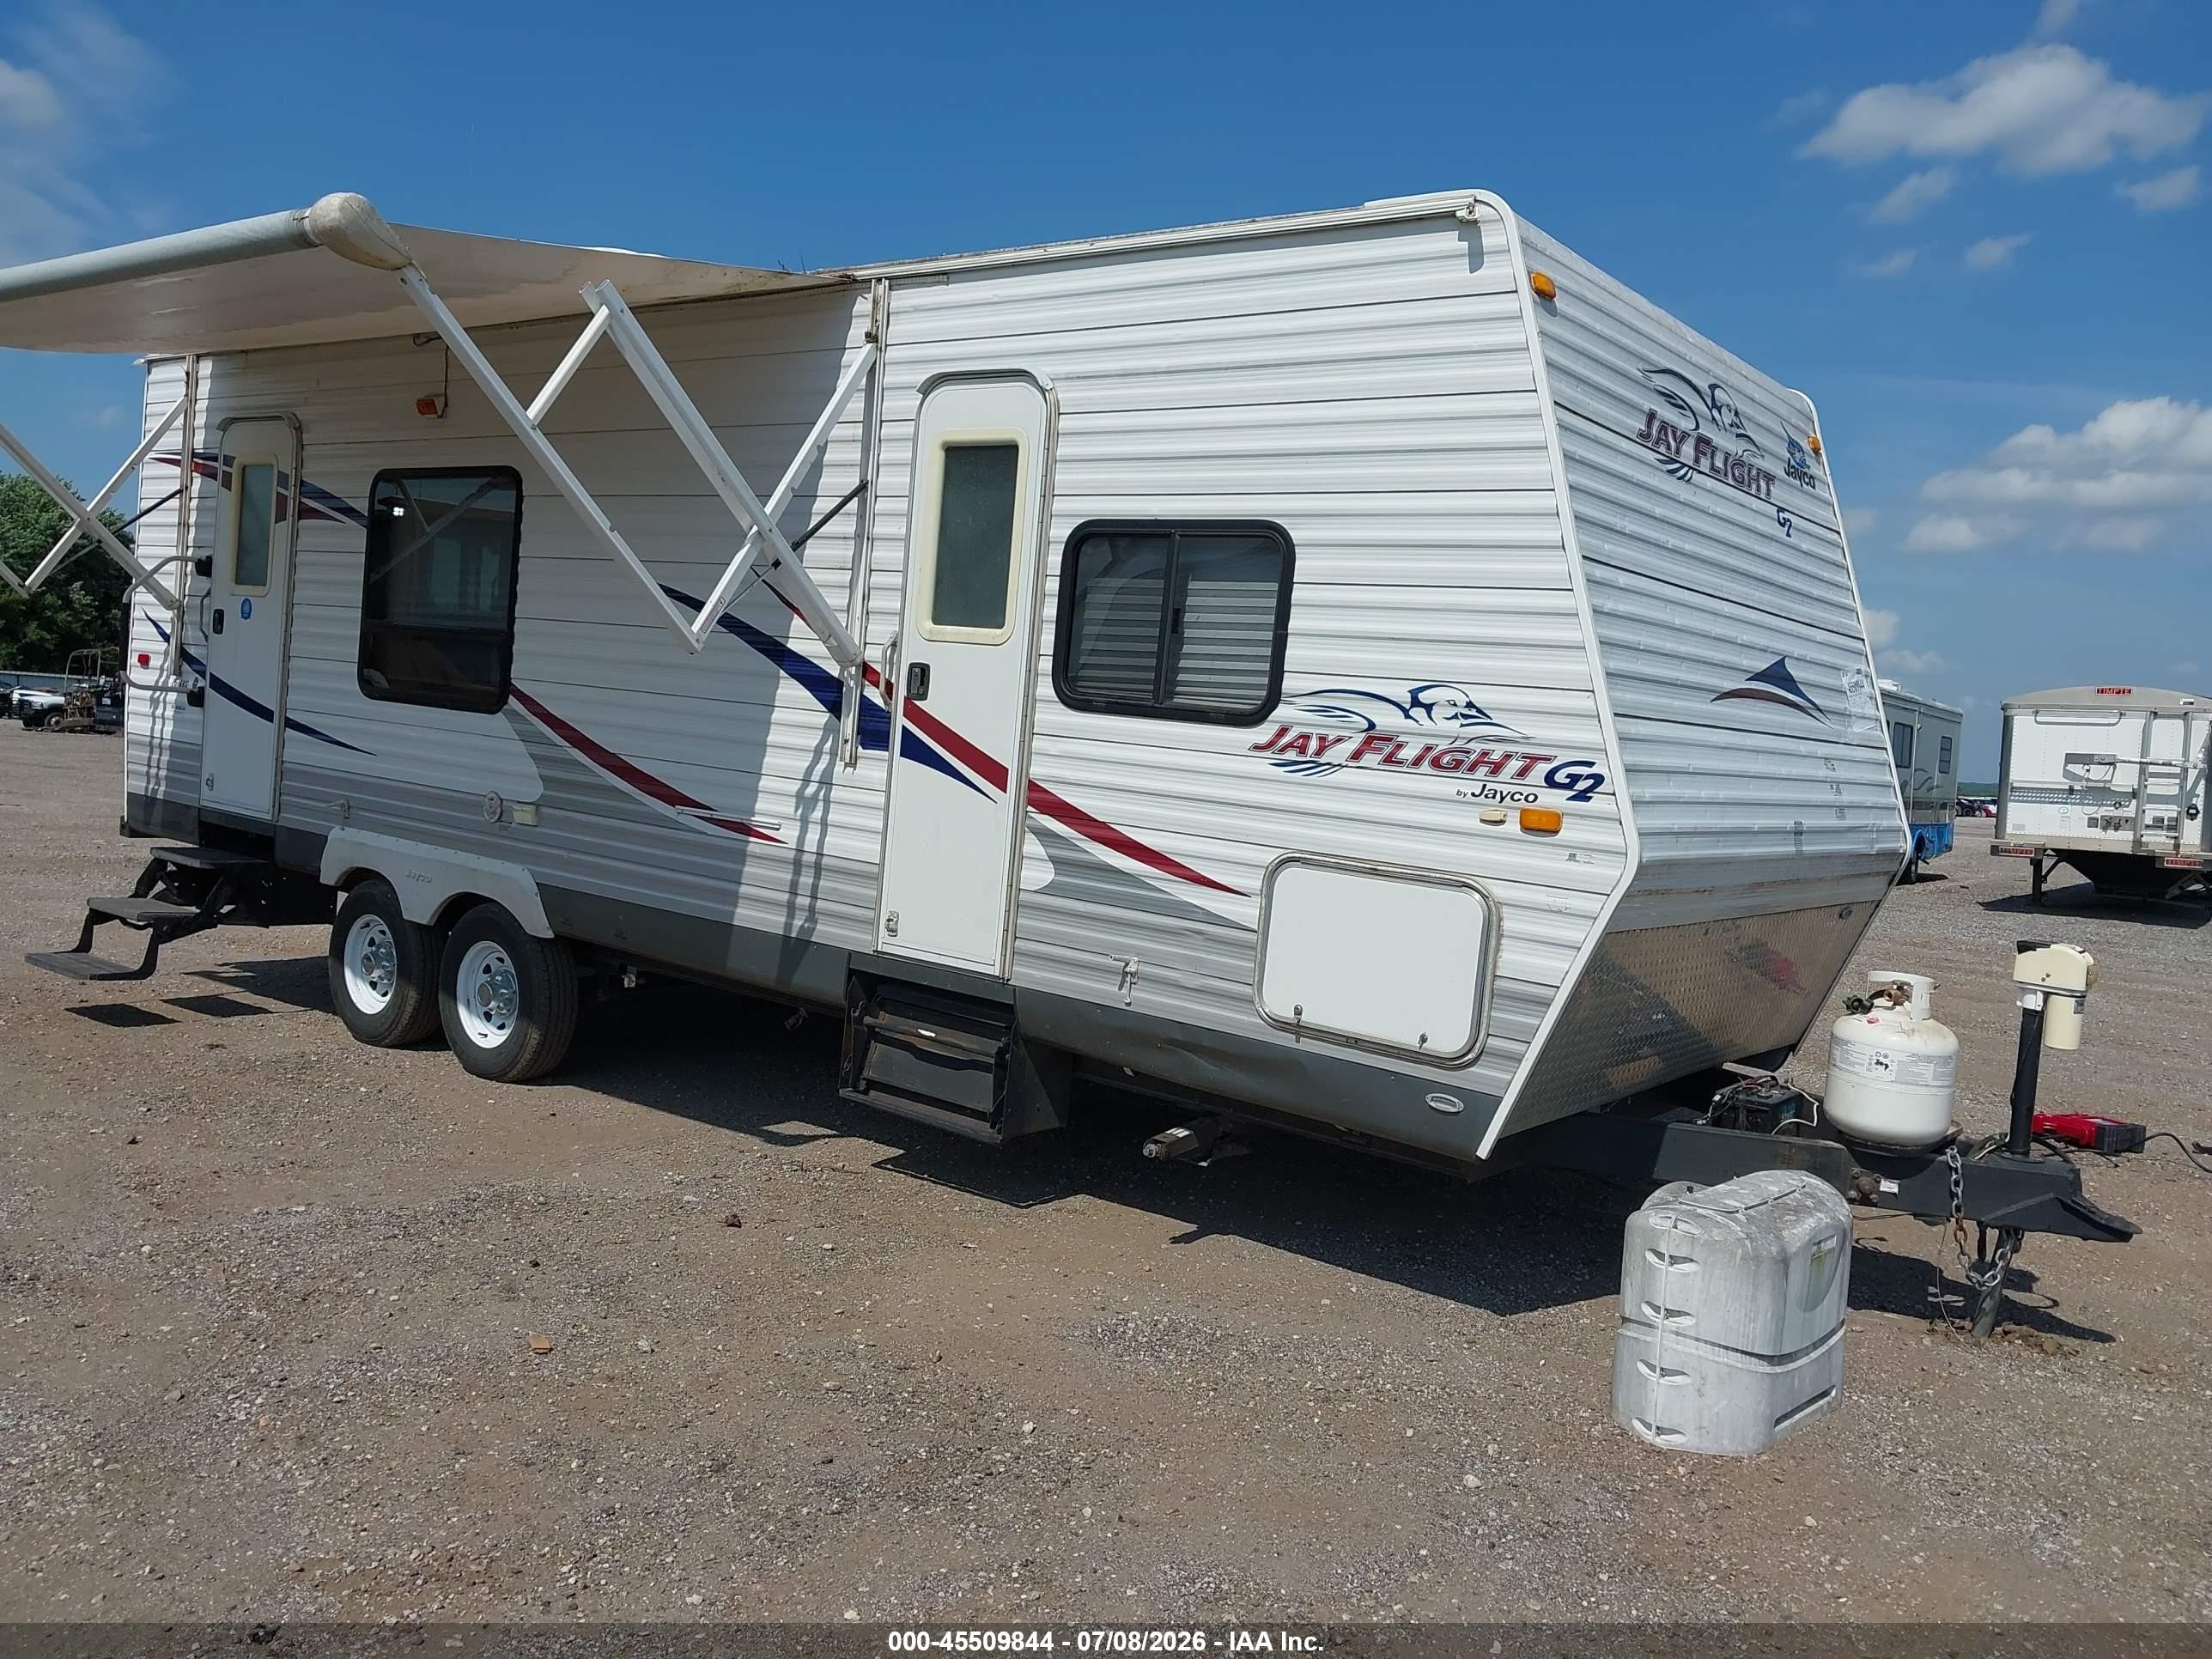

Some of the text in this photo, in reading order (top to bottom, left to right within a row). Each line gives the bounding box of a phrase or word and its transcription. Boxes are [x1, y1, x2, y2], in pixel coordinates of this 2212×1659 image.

[1636, 408, 1776, 500] JAY FLIGHT
[1784, 458, 1816, 490] Jayco
[1776, 507, 1792, 538] G2
[1249, 725, 1606, 803] JAY FLIGHT G2
[1455, 783, 1539, 805] by Jayco
